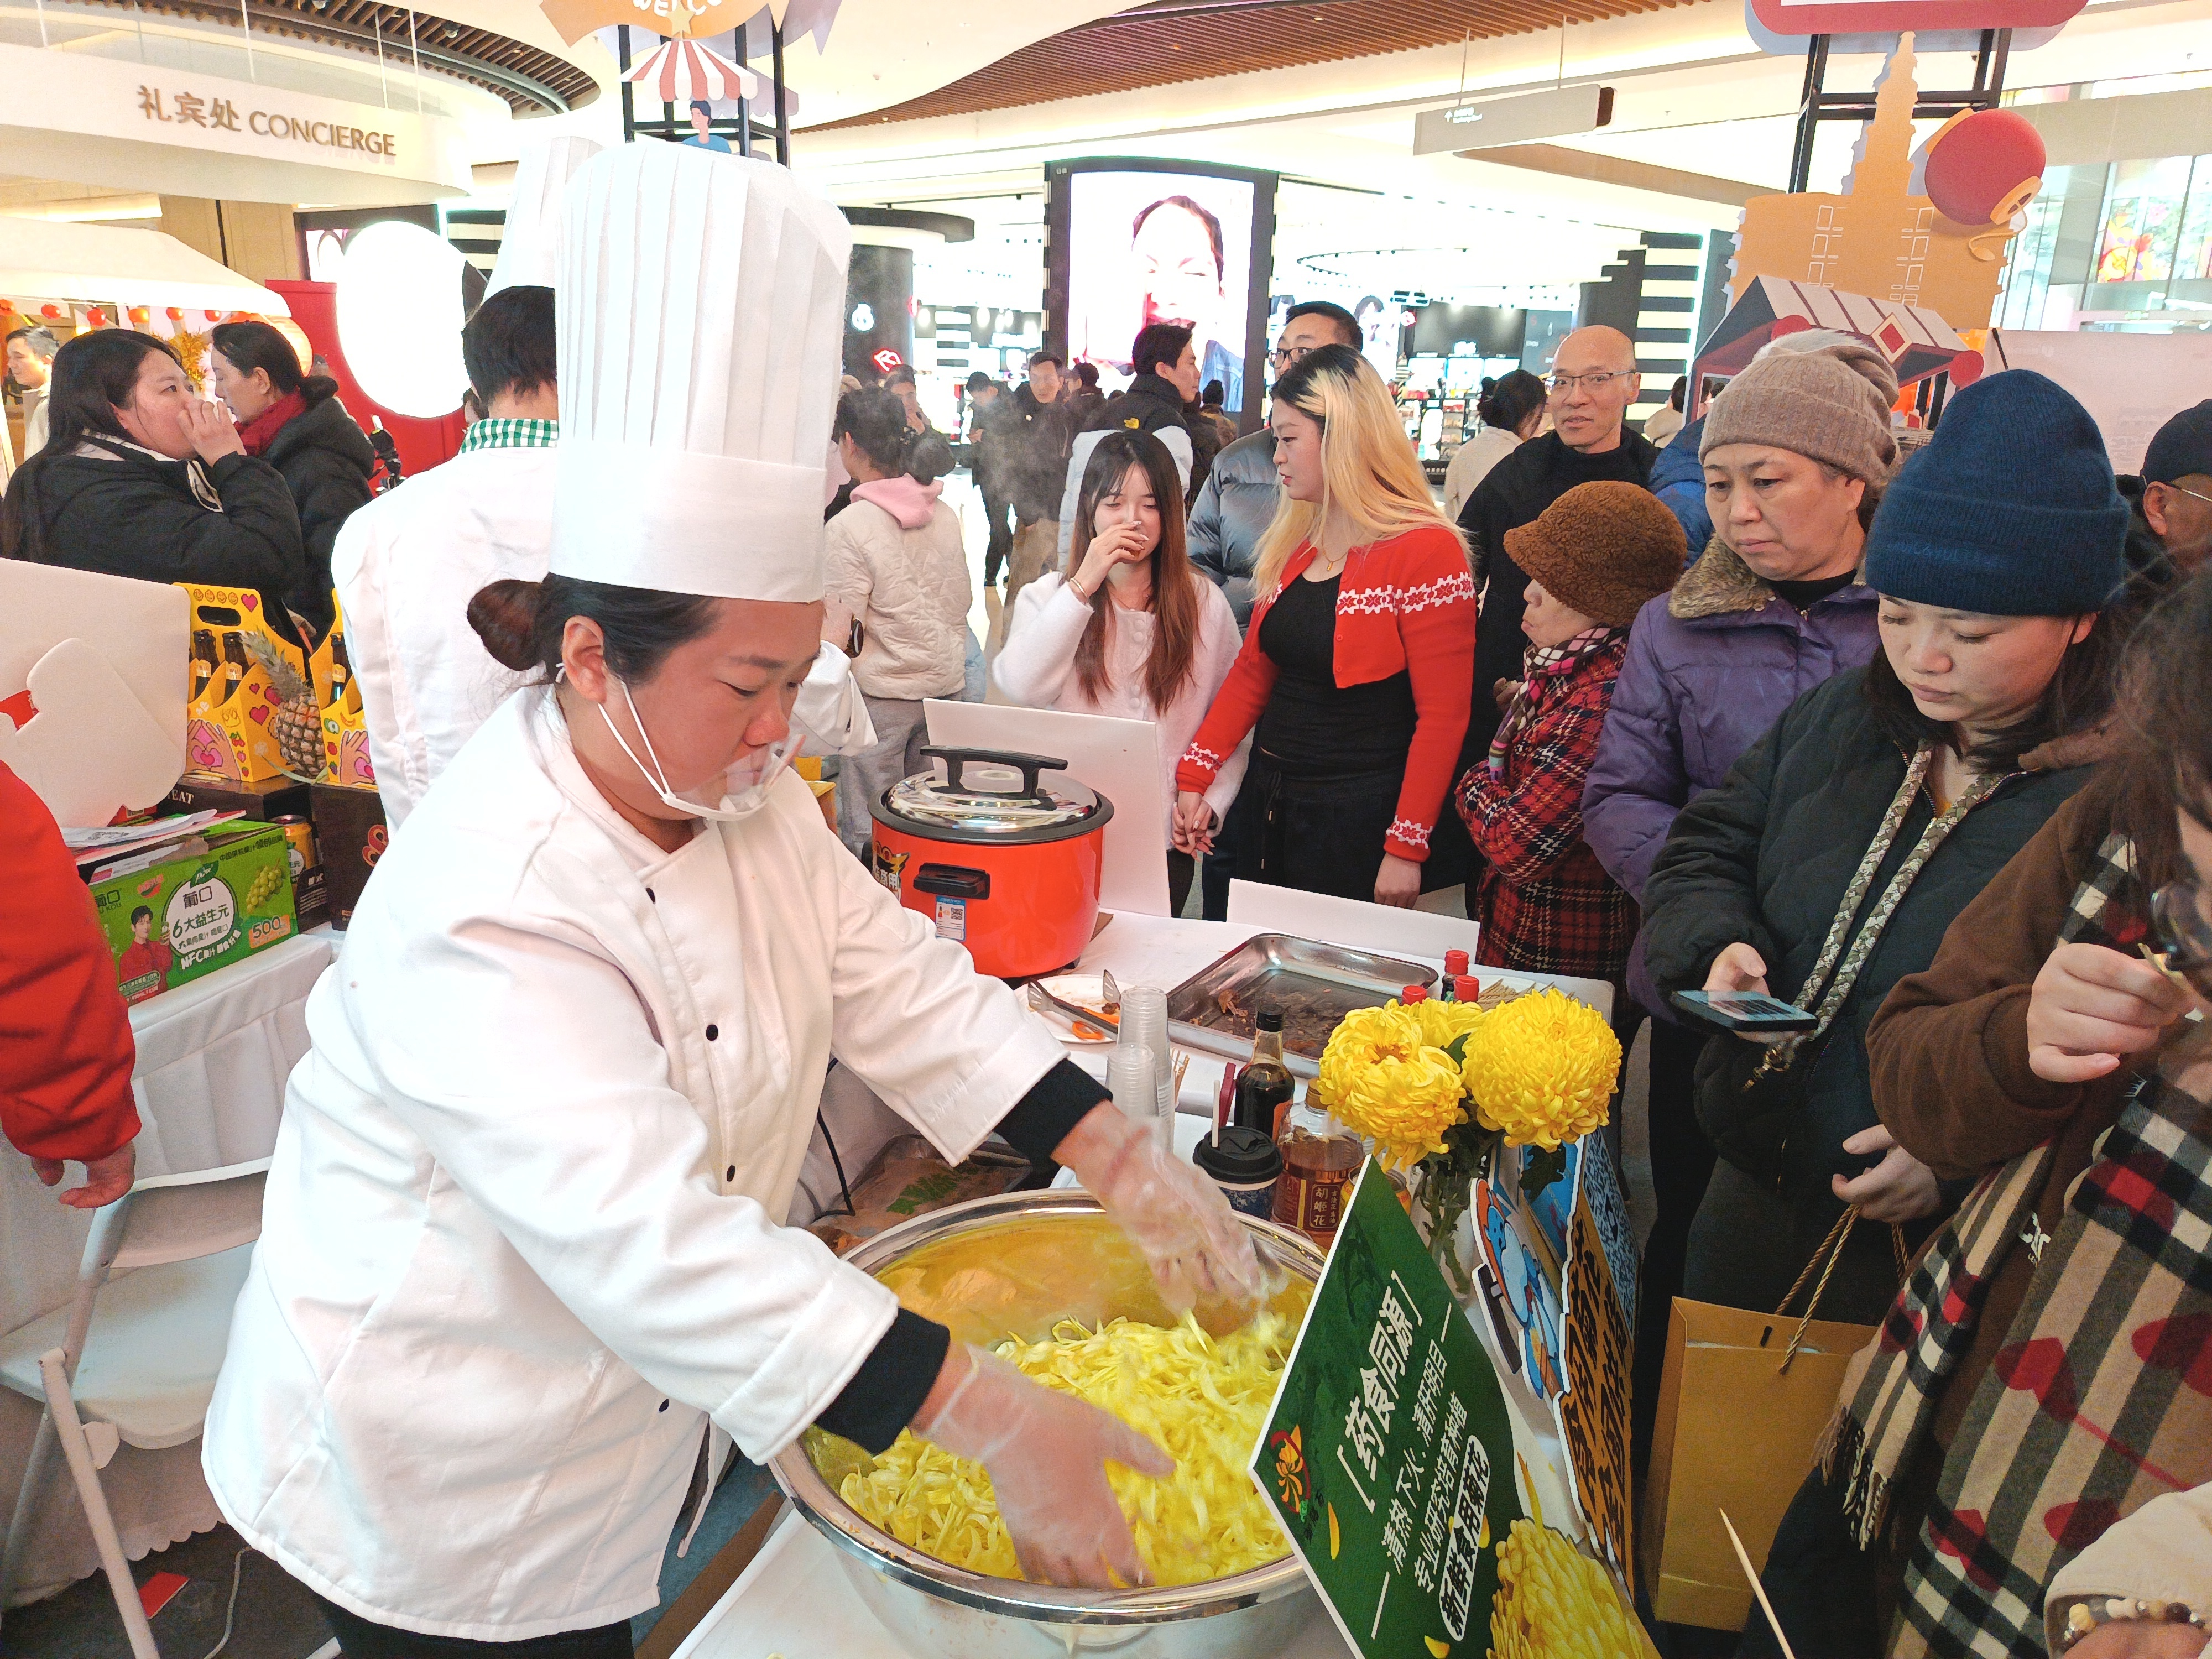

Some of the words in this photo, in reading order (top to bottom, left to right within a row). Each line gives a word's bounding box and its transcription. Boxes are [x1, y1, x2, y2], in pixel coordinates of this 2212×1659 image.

[138, 85, 242, 132] 礼宾处
[248, 111, 397, 156] CONCIERGE
[173, 903, 229, 938] 6大益生元
[1313, 1188, 1328, 1226] 胡姬花
[1414, 1390, 1467, 1593] 专业研究培育种植
[1441, 1440, 1490, 1636] 新鲜食用菊花
